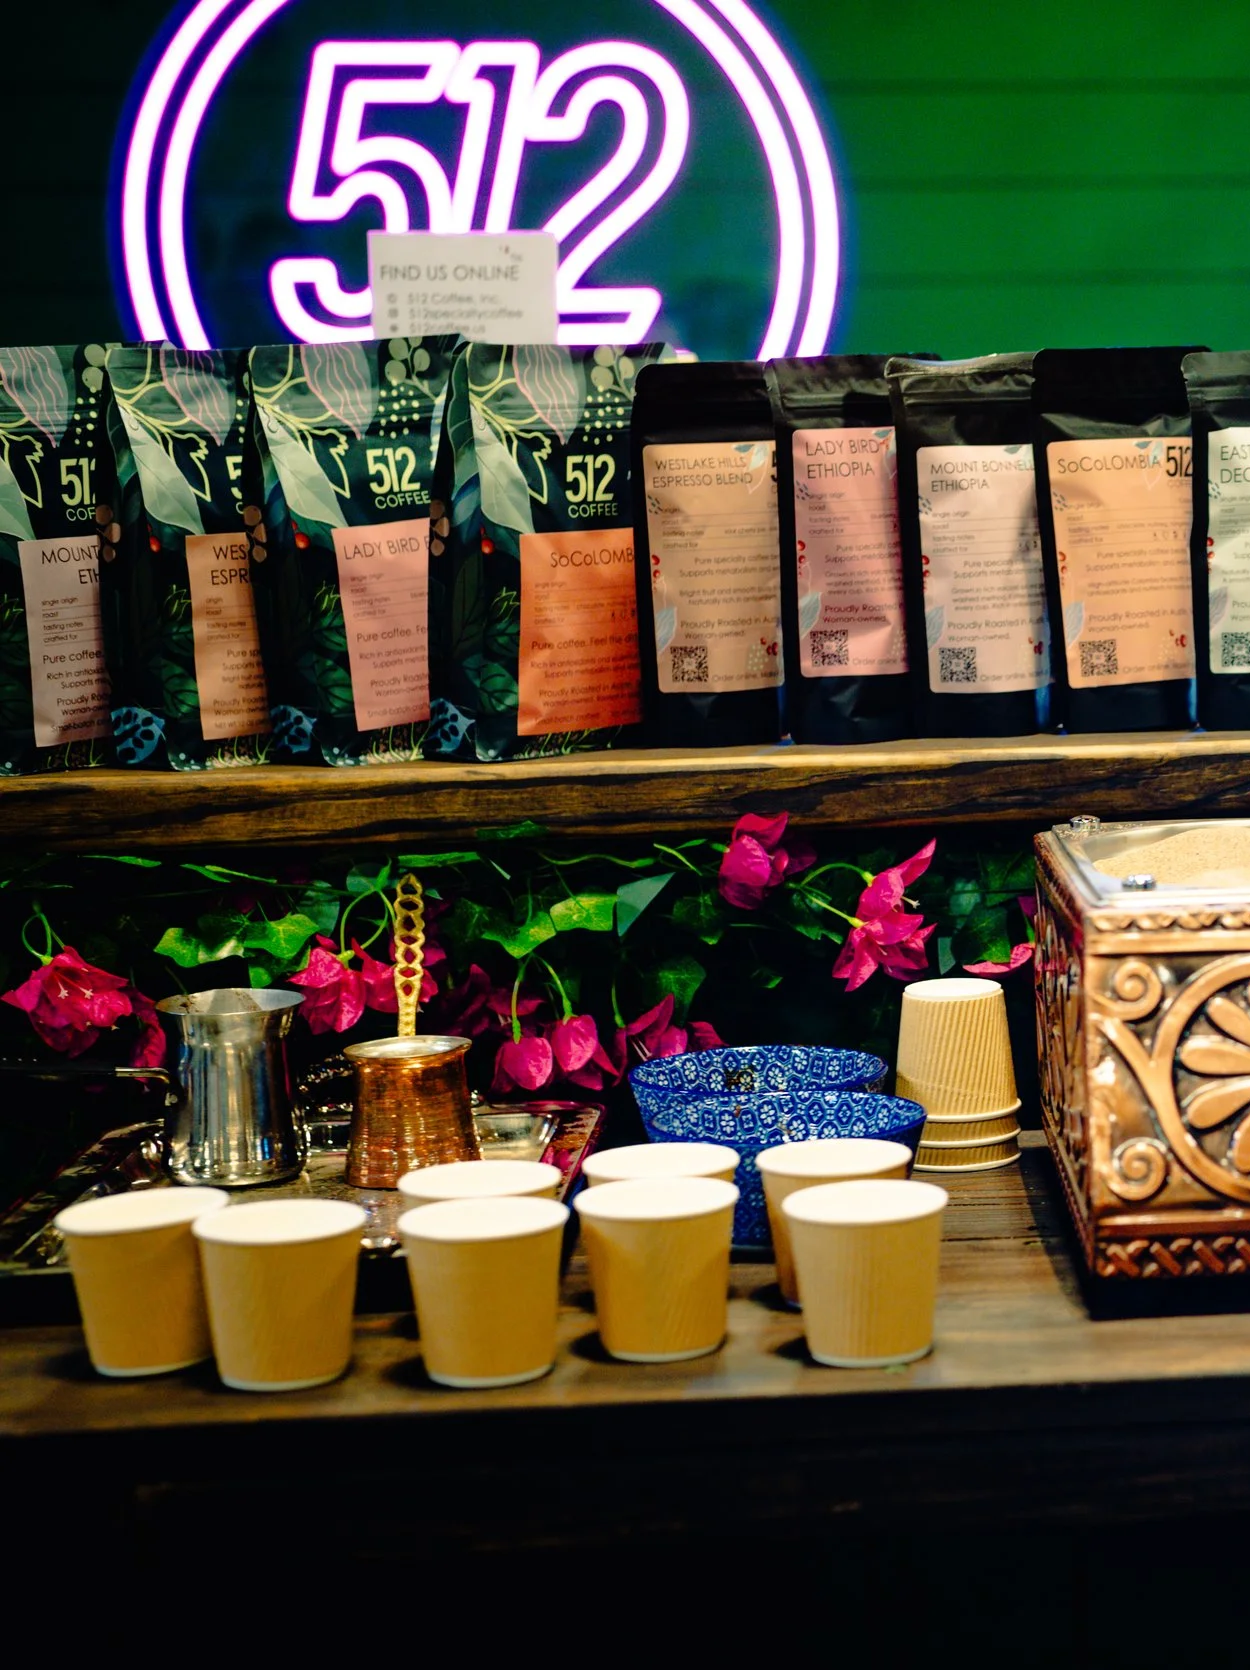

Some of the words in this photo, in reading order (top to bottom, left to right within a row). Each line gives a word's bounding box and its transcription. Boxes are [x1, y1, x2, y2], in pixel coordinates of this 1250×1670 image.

[270, 41, 689, 344] 512
[379, 264, 421, 281] FIND
[427, 264, 447, 281] US
[453, 264, 520, 281] ONLINE
[805, 440, 843, 456] LADY
[849, 439, 880, 454] BIRD
[655, 457, 717, 470] WESTLAKE
[718, 457, 747, 468] HILLS
[930, 461, 978, 475] MOUNT
[1057, 455, 1161, 474] SoCoLOMBIA
[1166, 446, 1192, 477] 512
[366, 446, 421, 494] 512
[807, 461, 875, 479] ETHIOPIA
[60, 458, 96, 506] 51
[565, 454, 615, 502] 512
[652, 473, 712, 488] ESPRESSO
[715, 472, 753, 485] BLEND
[931, 478, 990, 492] ETHIOPIA
[375, 490, 431, 510] COFFEE
[568, 503, 618, 518] COFFEE
[41, 545, 98, 565] MOUNT
[343, 542, 382, 561] LADY
[387, 537, 420, 555] BIRD
[825, 604, 859, 613] Proudly
[1088, 614, 1122, 622] Proudly
[1125, 610, 1160, 619] Roasted
[680, 620, 715, 629] Proudly
[717, 618, 752, 626] Roasted
[947, 621, 983, 630] Proudly
[984, 619, 1020, 627] Roasted
[356, 631, 379, 642] Pure
[531, 640, 555, 650] Pure
[43, 654, 66, 664] Pure
[47, 672, 64, 680] Rich
[370, 678, 400, 688] Proudly
[61, 679, 93, 689] Supports
[57, 695, 89, 706] Proudly
